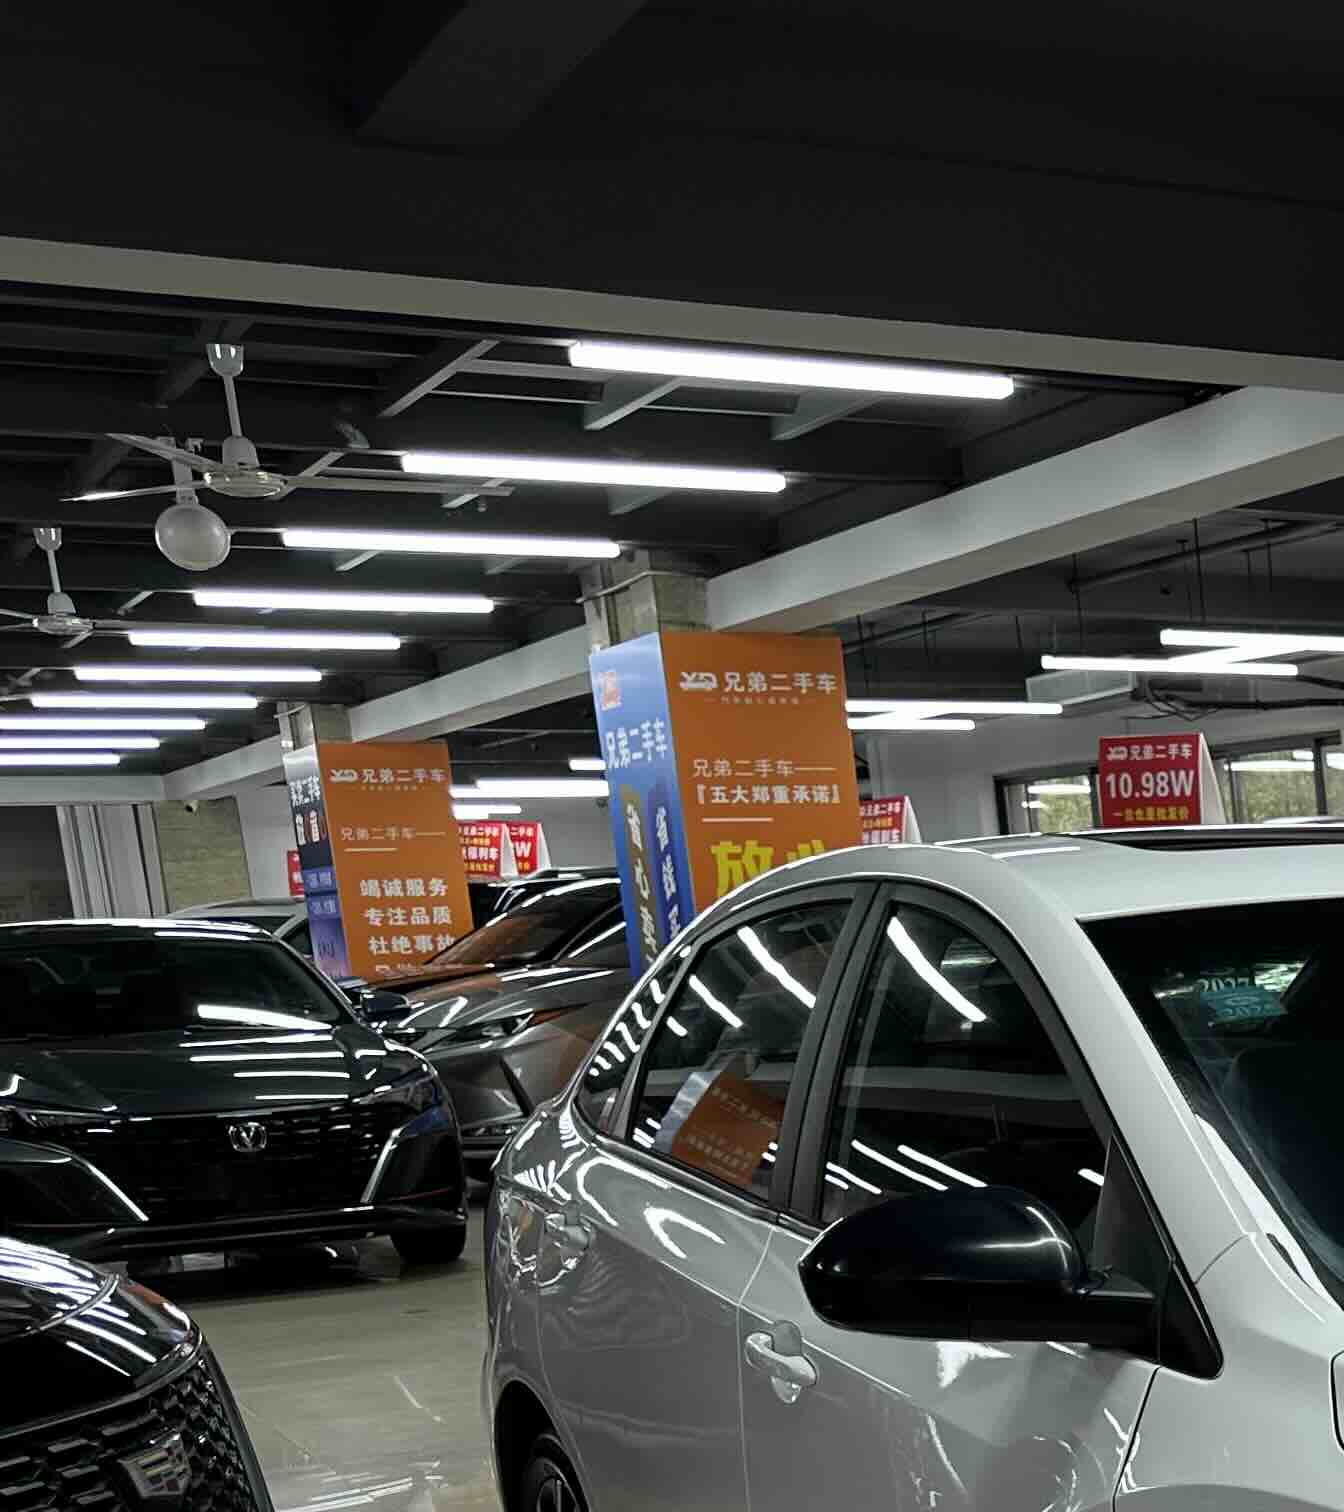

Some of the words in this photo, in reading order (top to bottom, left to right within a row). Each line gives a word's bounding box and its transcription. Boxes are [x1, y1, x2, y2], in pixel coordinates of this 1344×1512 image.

[724, 672, 838, 694] 兄弟二手车
[605, 717, 667, 769] 兄弟二手车
[1129, 743, 1193, 760] 兄弟二手车
[361, 767, 448, 784] 兄弟二手车
[1105, 769, 1195, 799] 10.98W
[365, 906, 453, 928] 专注品质
